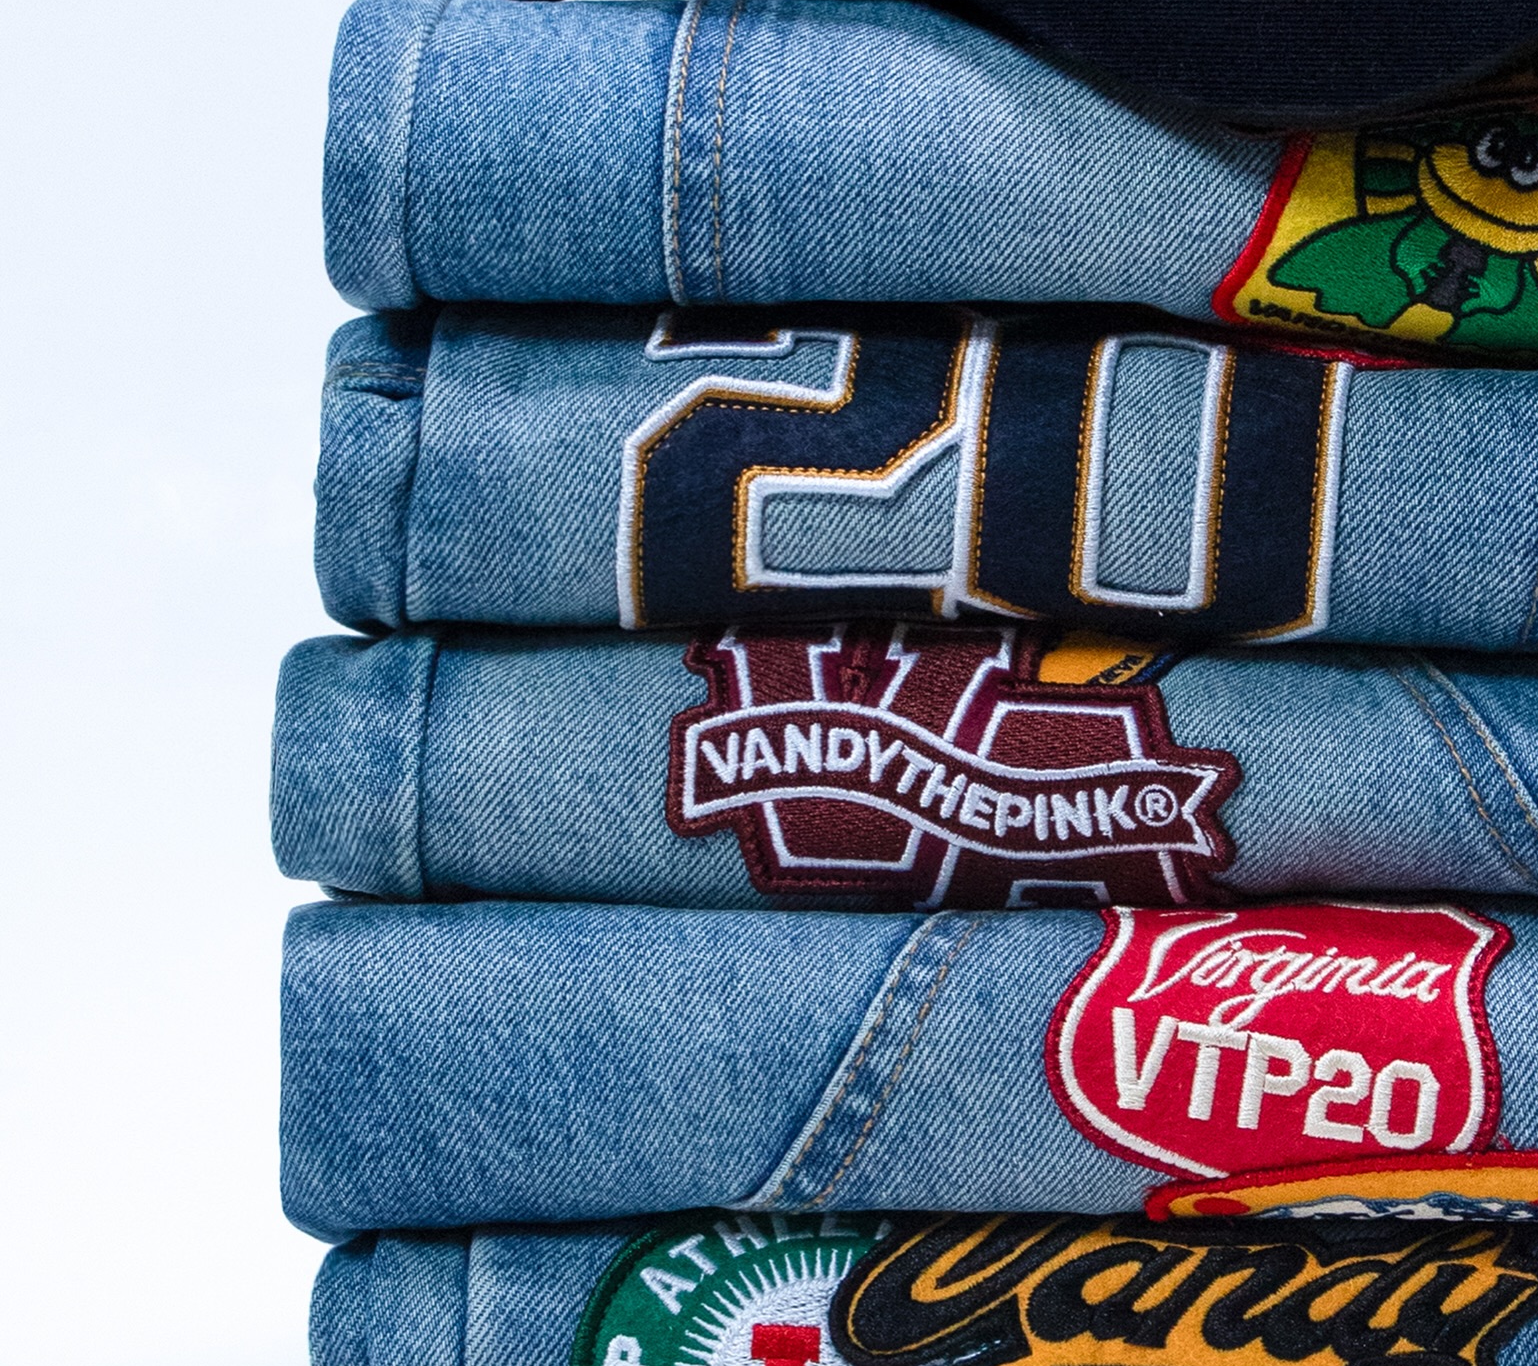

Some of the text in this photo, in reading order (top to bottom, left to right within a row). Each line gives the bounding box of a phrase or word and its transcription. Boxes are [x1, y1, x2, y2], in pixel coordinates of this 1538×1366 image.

[617, 305, 1350, 640] 20
[1127, 910, 1453, 1029] Virginia
[1111, 1006, 1440, 1150] VTP20
